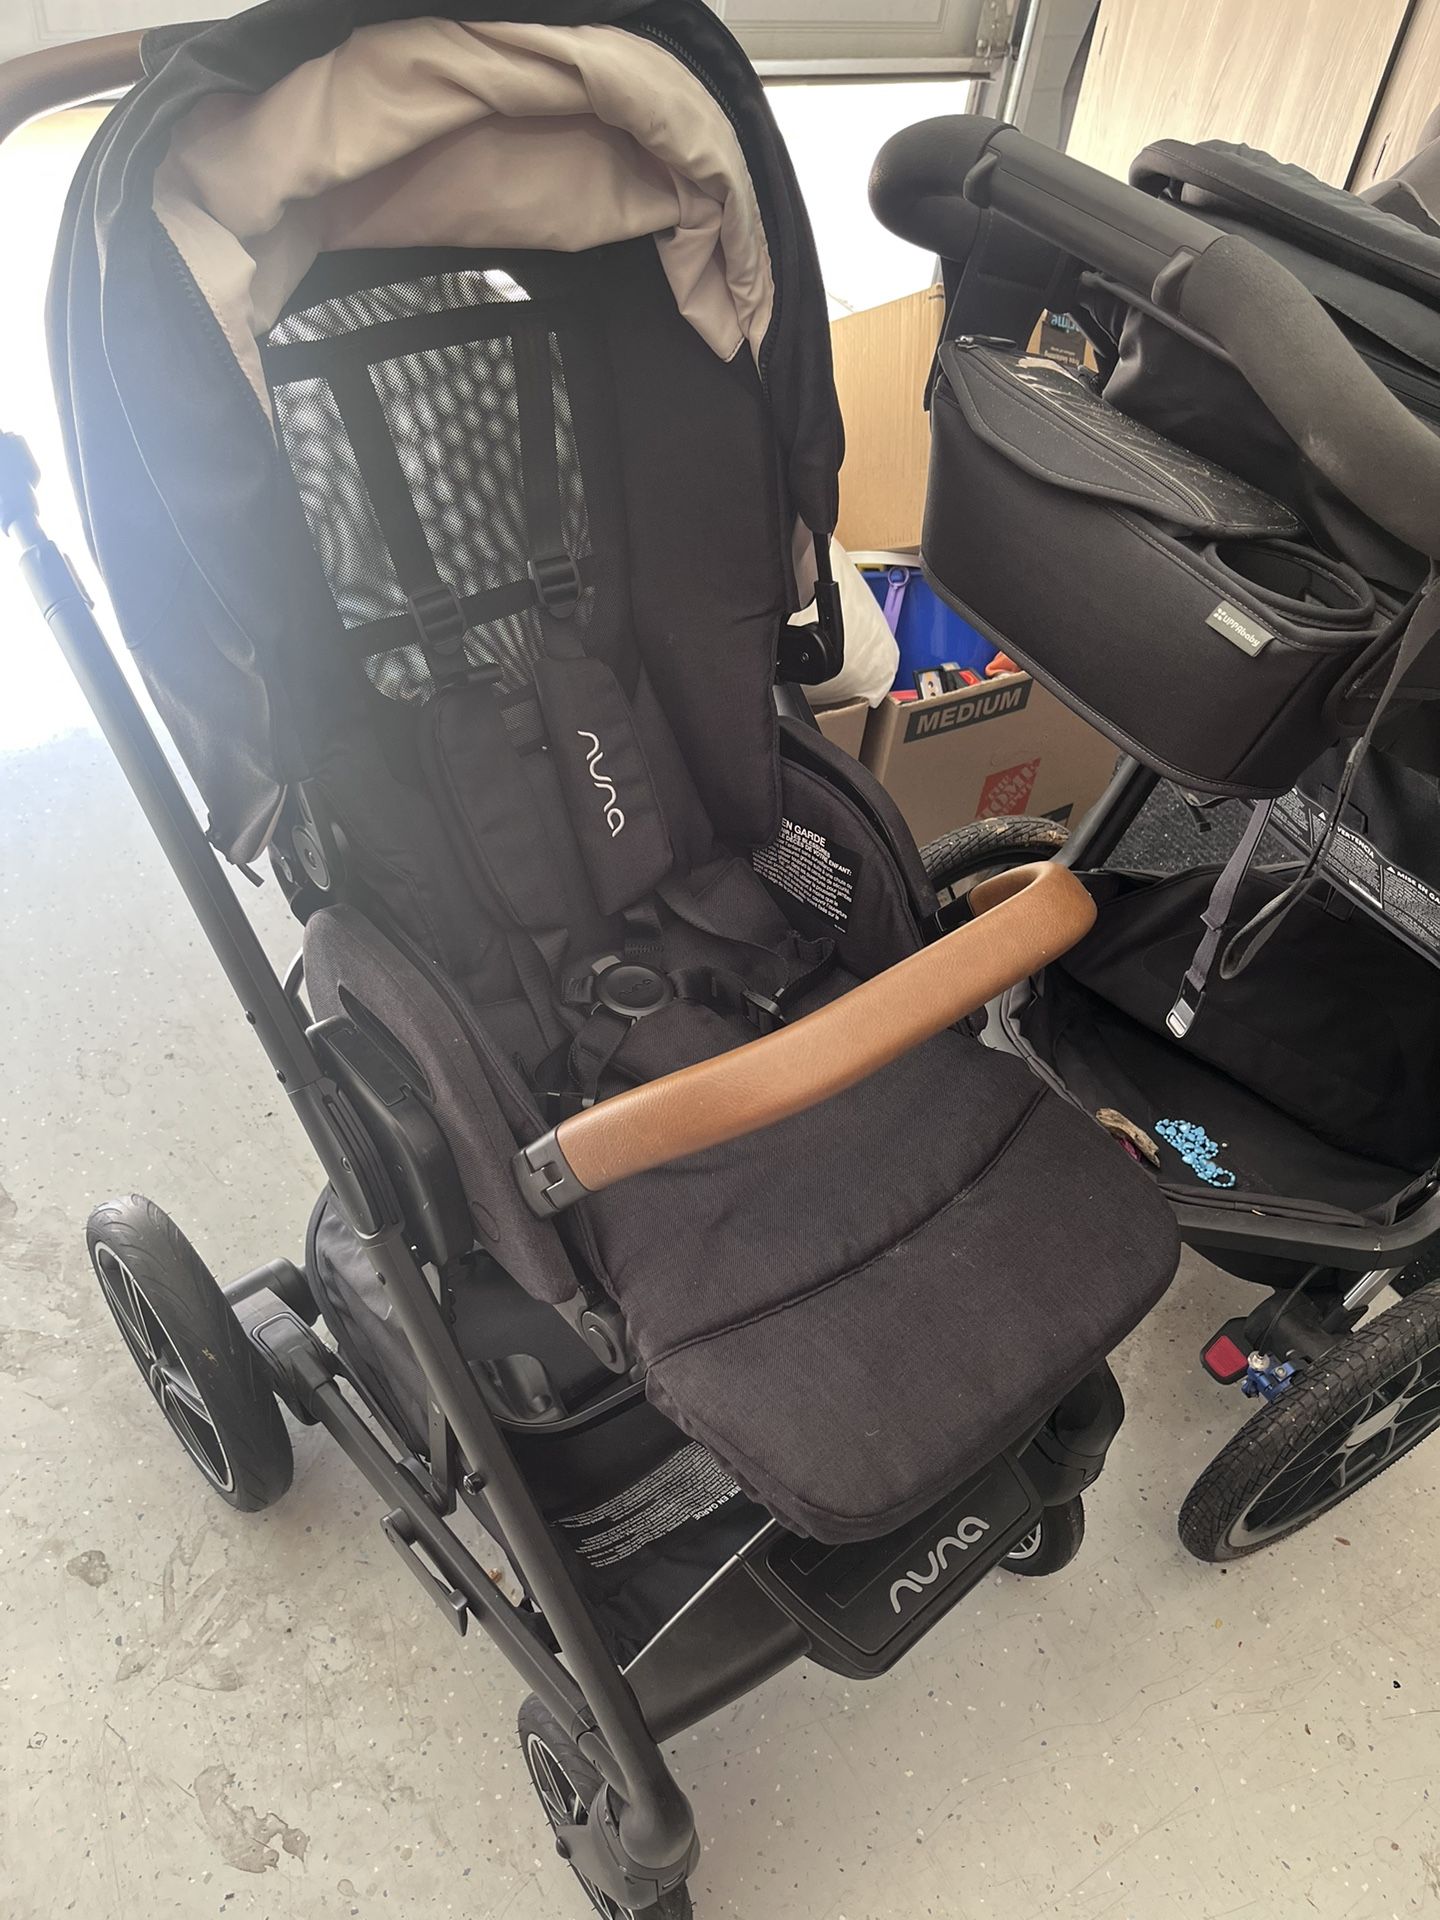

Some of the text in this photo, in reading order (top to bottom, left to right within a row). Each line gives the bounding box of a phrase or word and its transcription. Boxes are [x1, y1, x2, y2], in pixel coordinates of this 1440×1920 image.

[915, 687, 1023, 735] MEDIUM
[577, 730, 625, 838] nuna
[794, 825, 827, 847] GARDE
[1332, 824, 1374, 859] VERTENCIA
[890, 1516, 990, 1614] nuna
